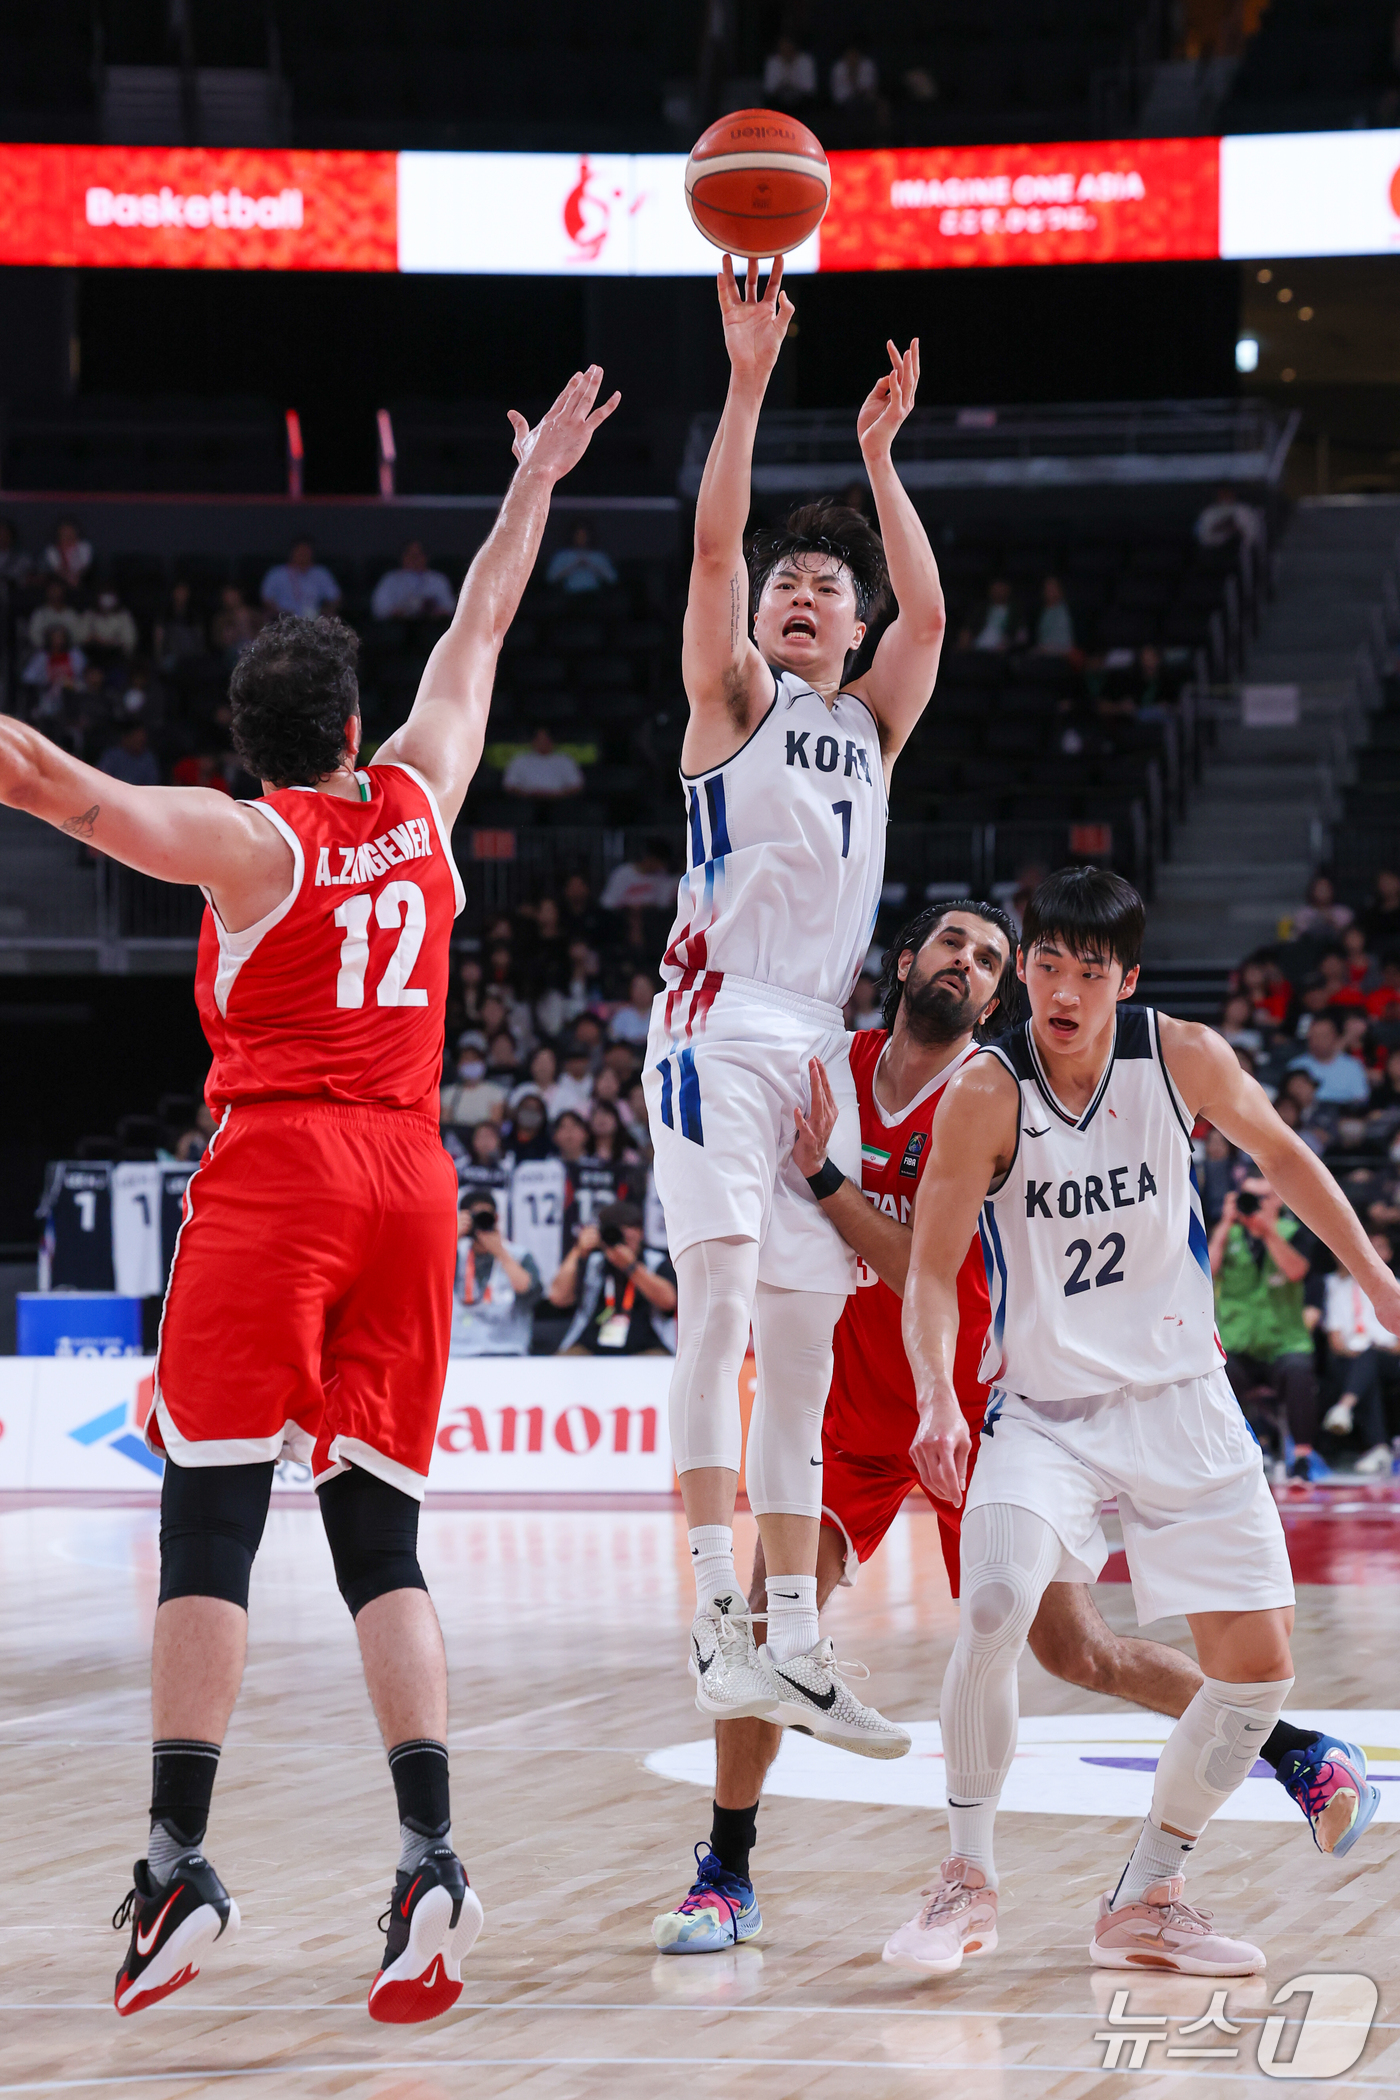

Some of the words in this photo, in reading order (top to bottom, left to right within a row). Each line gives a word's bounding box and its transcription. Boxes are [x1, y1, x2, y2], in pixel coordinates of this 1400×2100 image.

[730, 126, 796, 141] molten
[86, 186, 304, 230] Basketball
[891, 175, 1011, 209] IMAGINE
[1012, 173, 1075, 206] ONE
[1076, 171, 1146, 203] ASIA
[314, 816, 433, 887] A.ZANGENEH
[831, 799, 853, 859] 1
[333, 879, 430, 1009] 12
[73, 1190, 97, 1233] 1
[133, 1193, 151, 1227] 1
[525, 1191, 558, 1226] 12
[1025, 1161, 1158, 1219] KOREA
[1063, 1231, 1126, 1298] 22
[436, 1405, 658, 1455] anon
